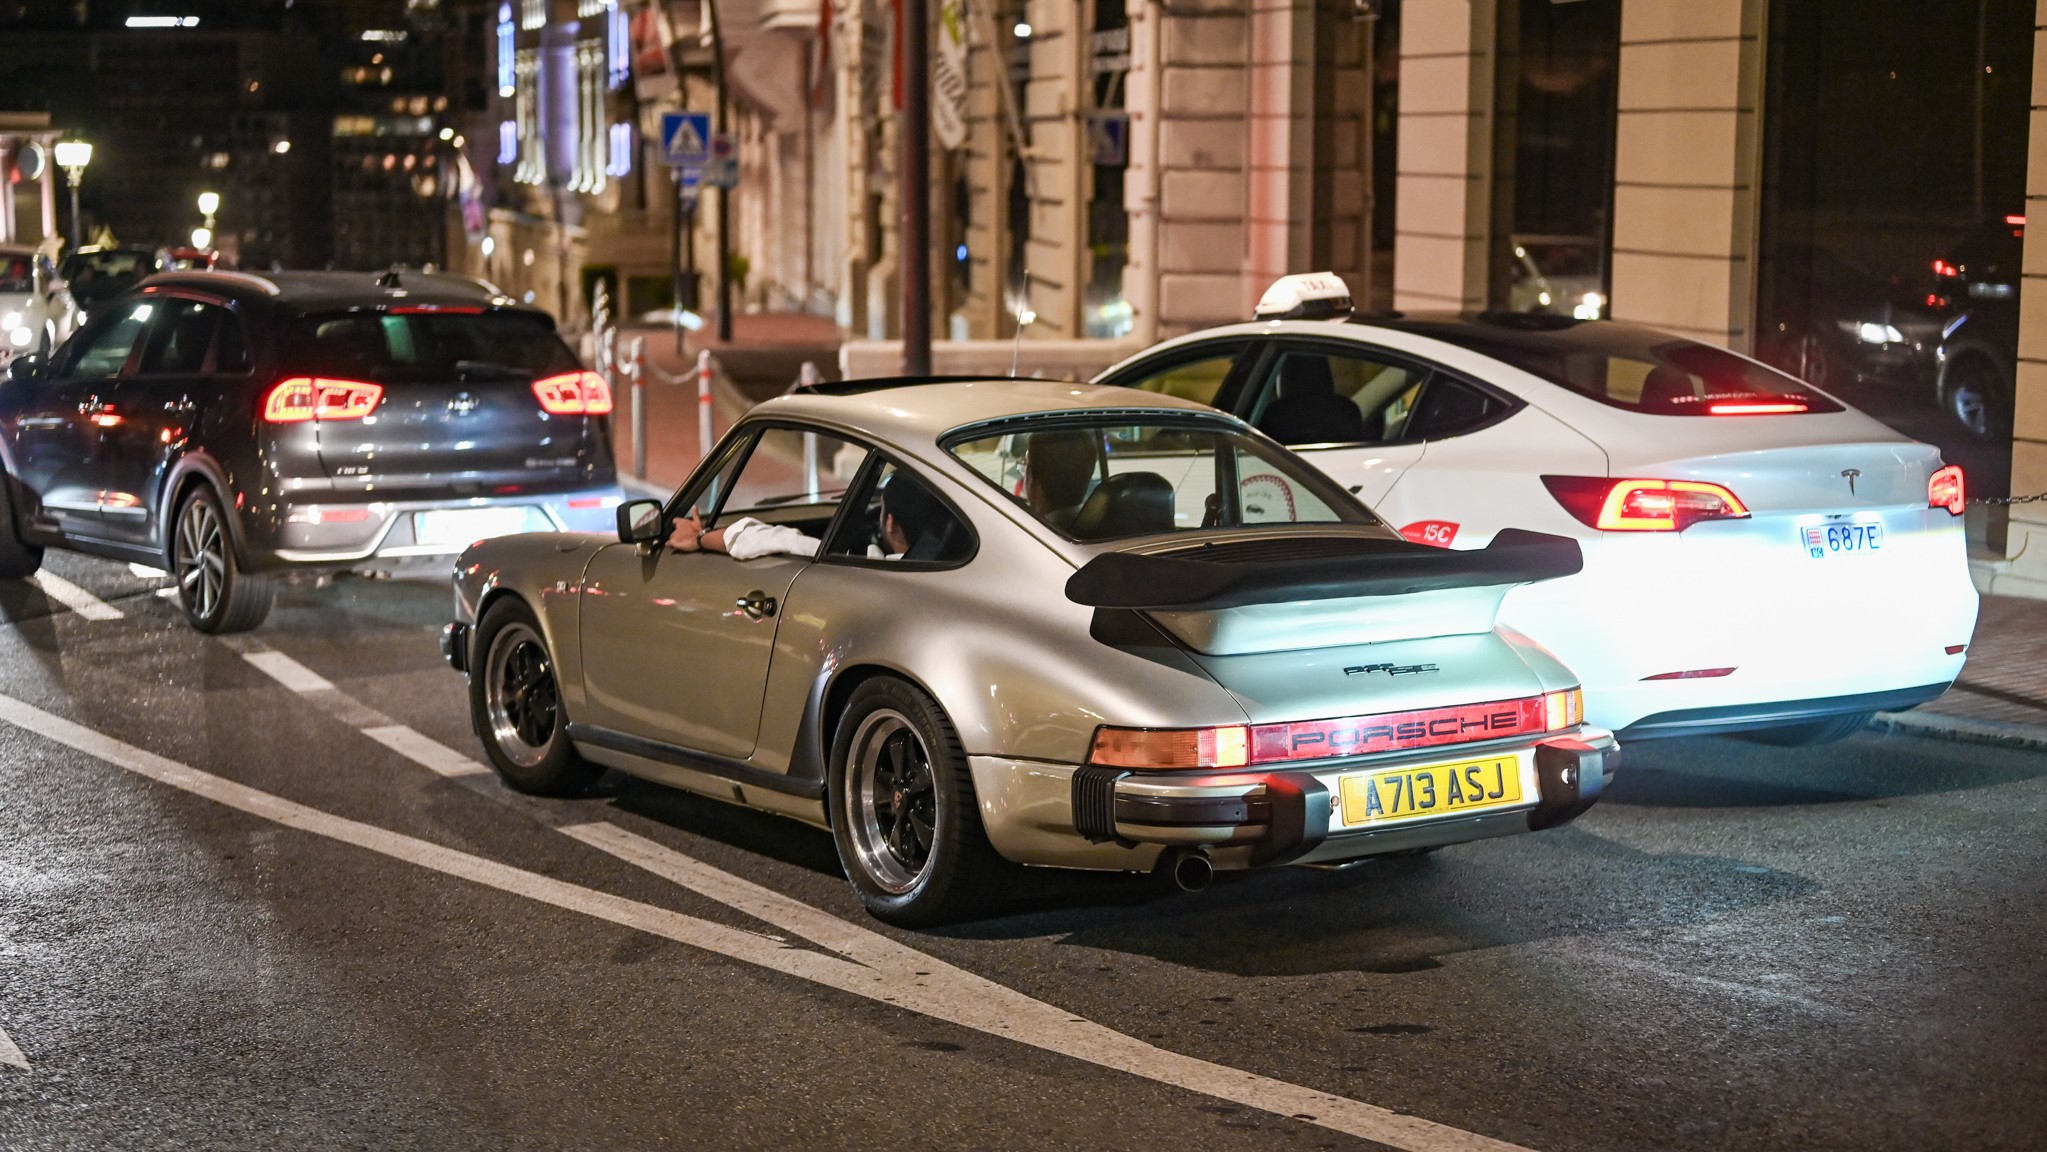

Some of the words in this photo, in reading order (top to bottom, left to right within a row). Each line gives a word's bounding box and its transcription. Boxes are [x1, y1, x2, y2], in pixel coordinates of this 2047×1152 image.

[1827, 525, 1880, 552] 687E
[1291, 711, 1518, 751] PORSCHE
[1365, 772, 1437, 817] A713
[1447, 763, 1505, 806] ASJ
